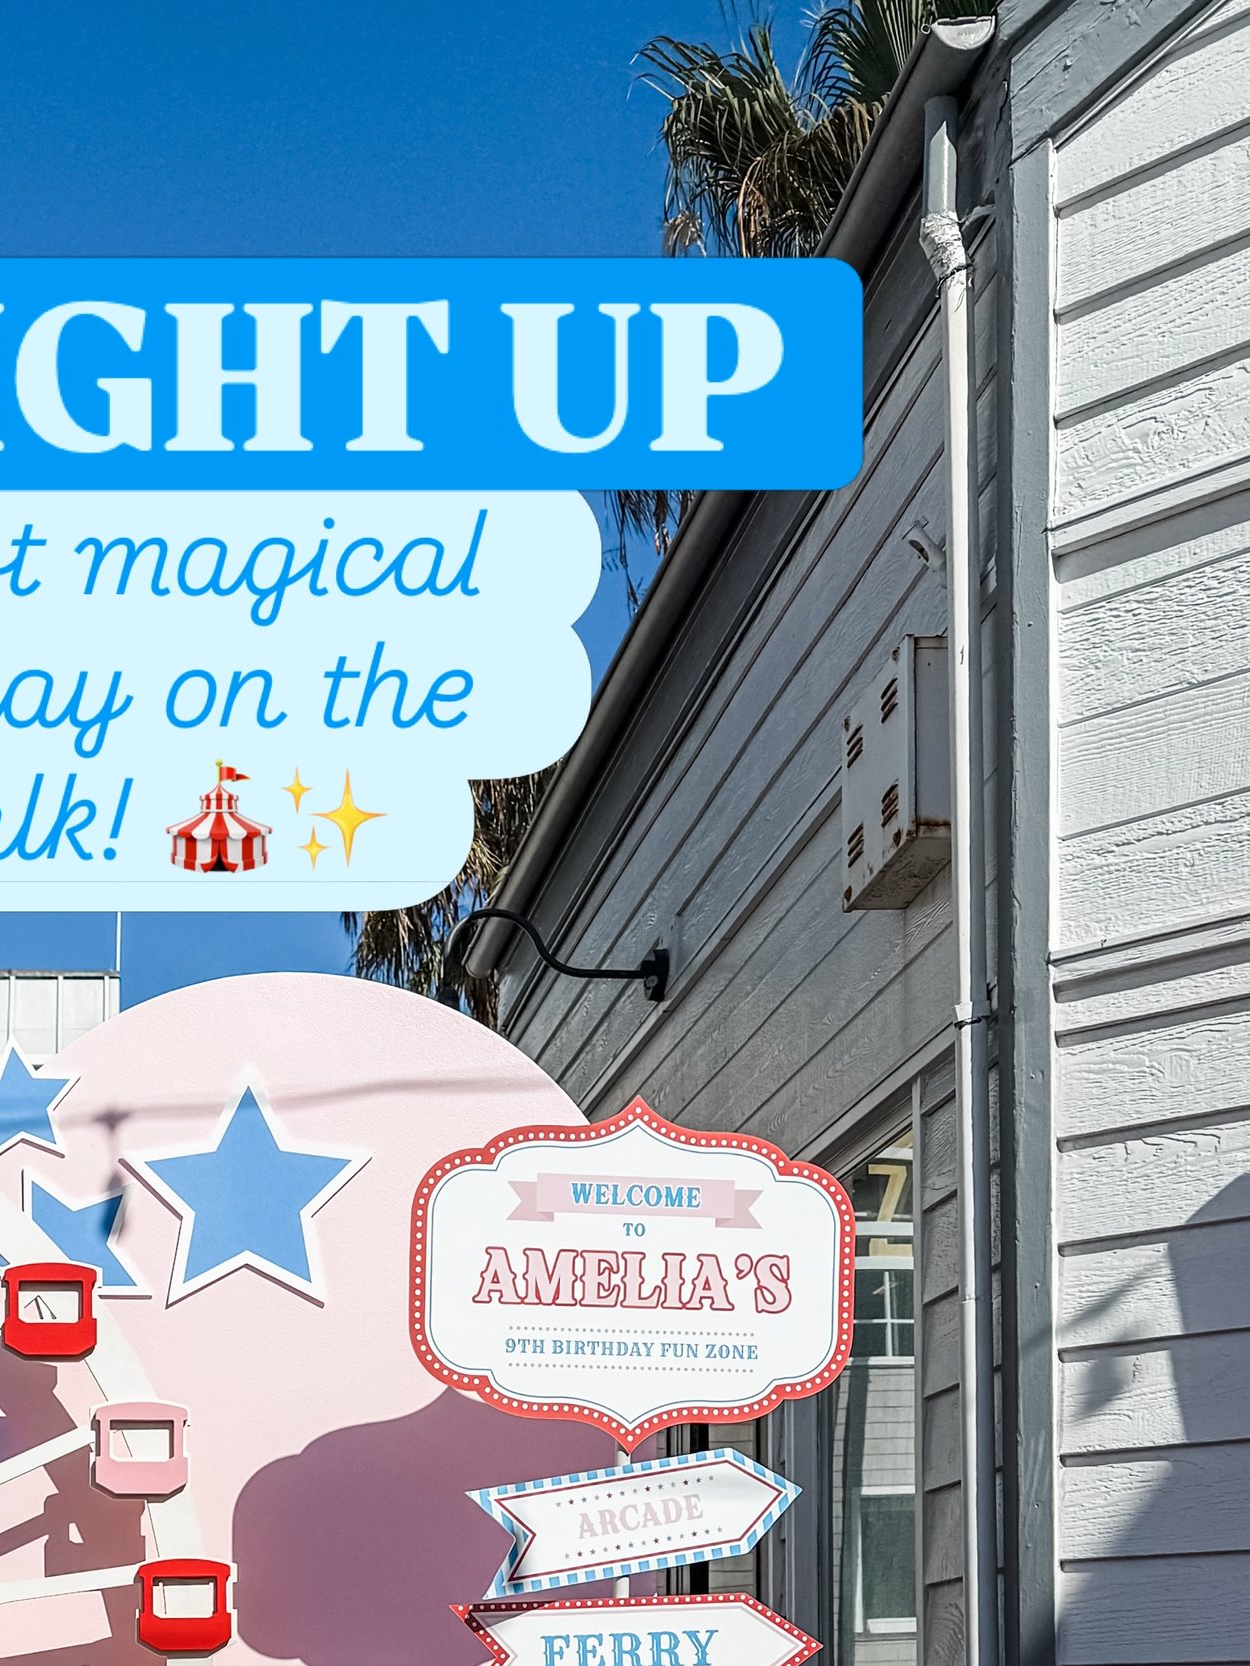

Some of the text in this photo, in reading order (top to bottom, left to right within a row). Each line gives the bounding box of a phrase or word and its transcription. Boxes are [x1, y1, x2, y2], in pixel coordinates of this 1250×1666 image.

[570, 1182, 701, 1209] WELCOME
[622, 1223, 646, 1238] TO
[472, 1246, 792, 1315] AMELIA'S
[504, 1338, 759, 1360] 9TH BIRTHDAY FUN ZONE
[578, 1493, 704, 1540] ARCADE
